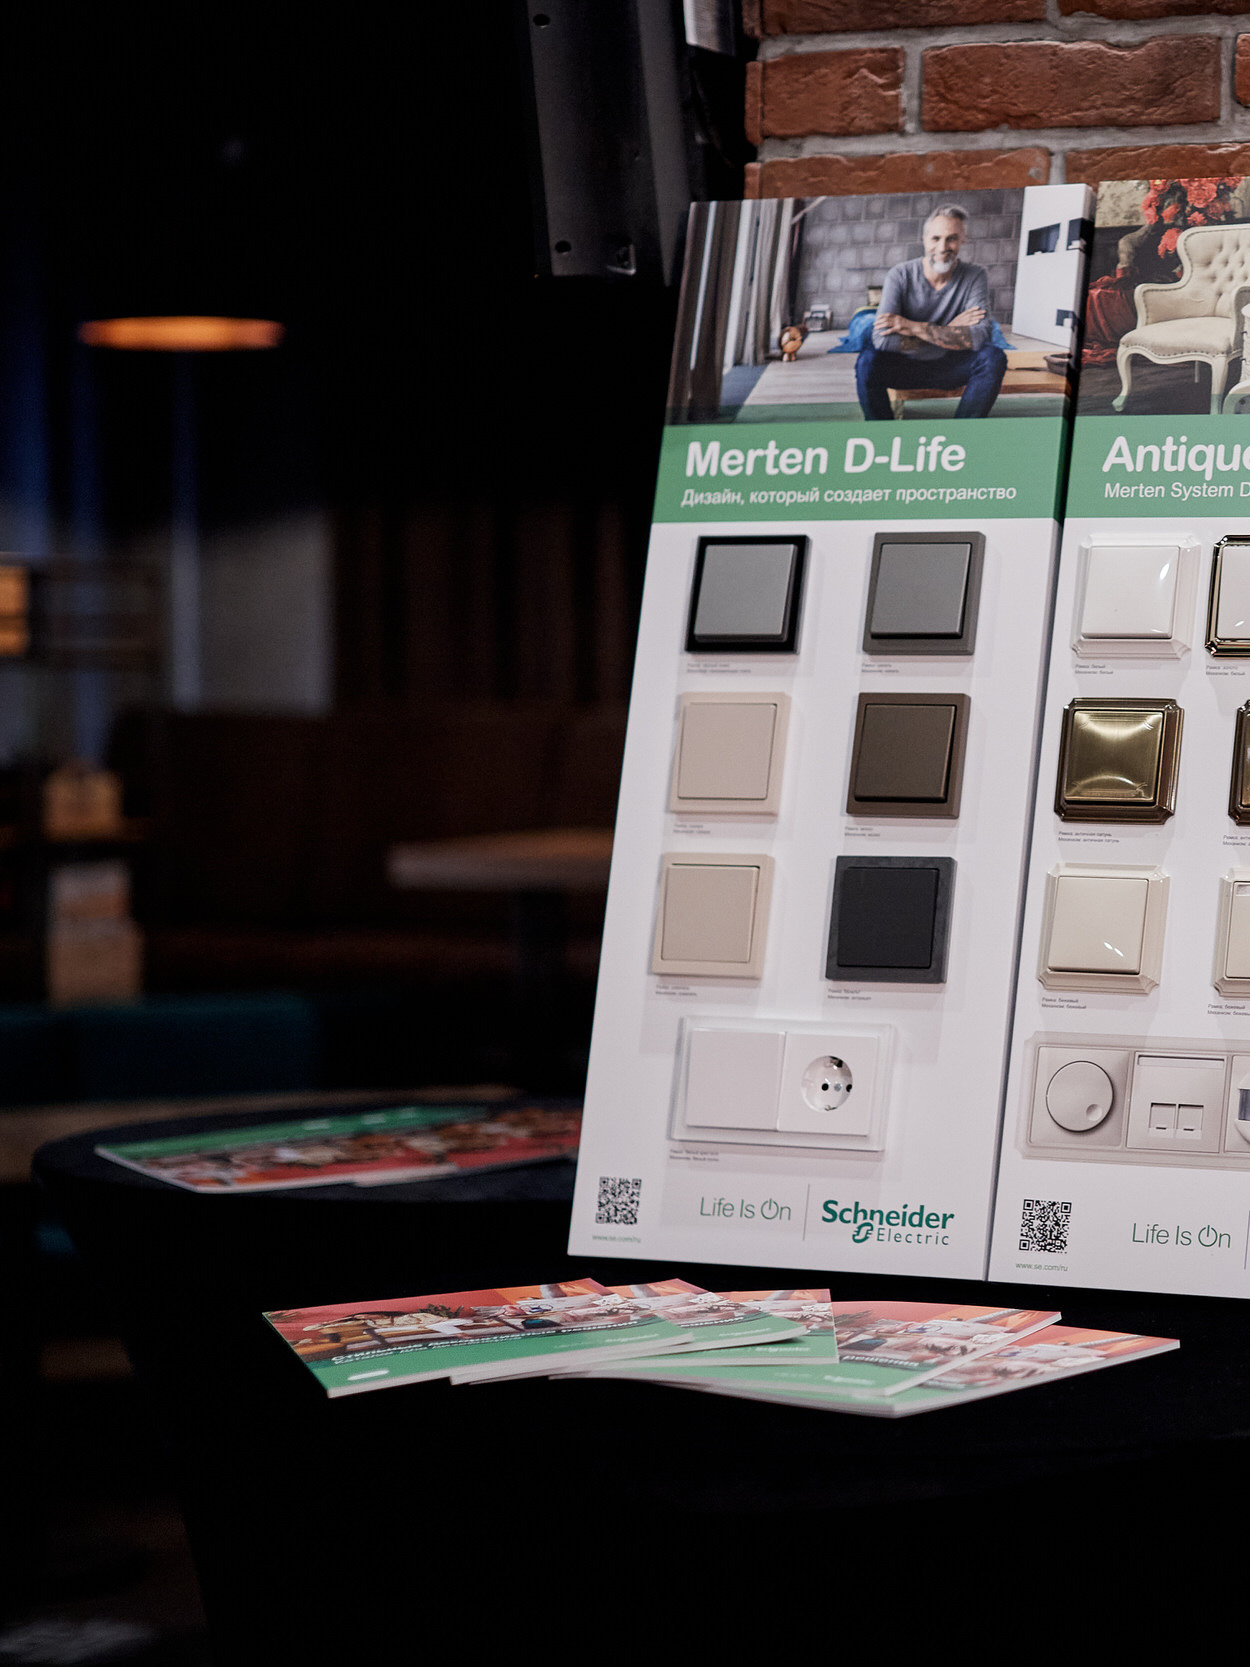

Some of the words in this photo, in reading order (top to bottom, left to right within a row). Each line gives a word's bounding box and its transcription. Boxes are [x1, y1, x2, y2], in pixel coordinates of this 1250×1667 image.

[685, 440, 829, 477] Merten
[844, 435, 966, 474] D-Life
[681, 488, 745, 508] Дизайн,
[749, 486, 820, 506] который
[823, 488, 892, 504] создает
[896, 486, 1017, 504] пространство
[1104, 482, 1166, 498] Merten
[1170, 481, 1234, 501] System
[700, 1196, 734, 1217] Life
[740, 1199, 755, 1218] Is
[760, 1198, 792, 1221] On
[821, 1199, 955, 1230] Schneider
[876, 1226, 949, 1246] Electric
[1132, 1222, 1169, 1245] Life
[1175, 1225, 1192, 1246] Is
[1198, 1224, 1231, 1248] On
[1015, 1262, 1069, 1272] www.se.com/ru
